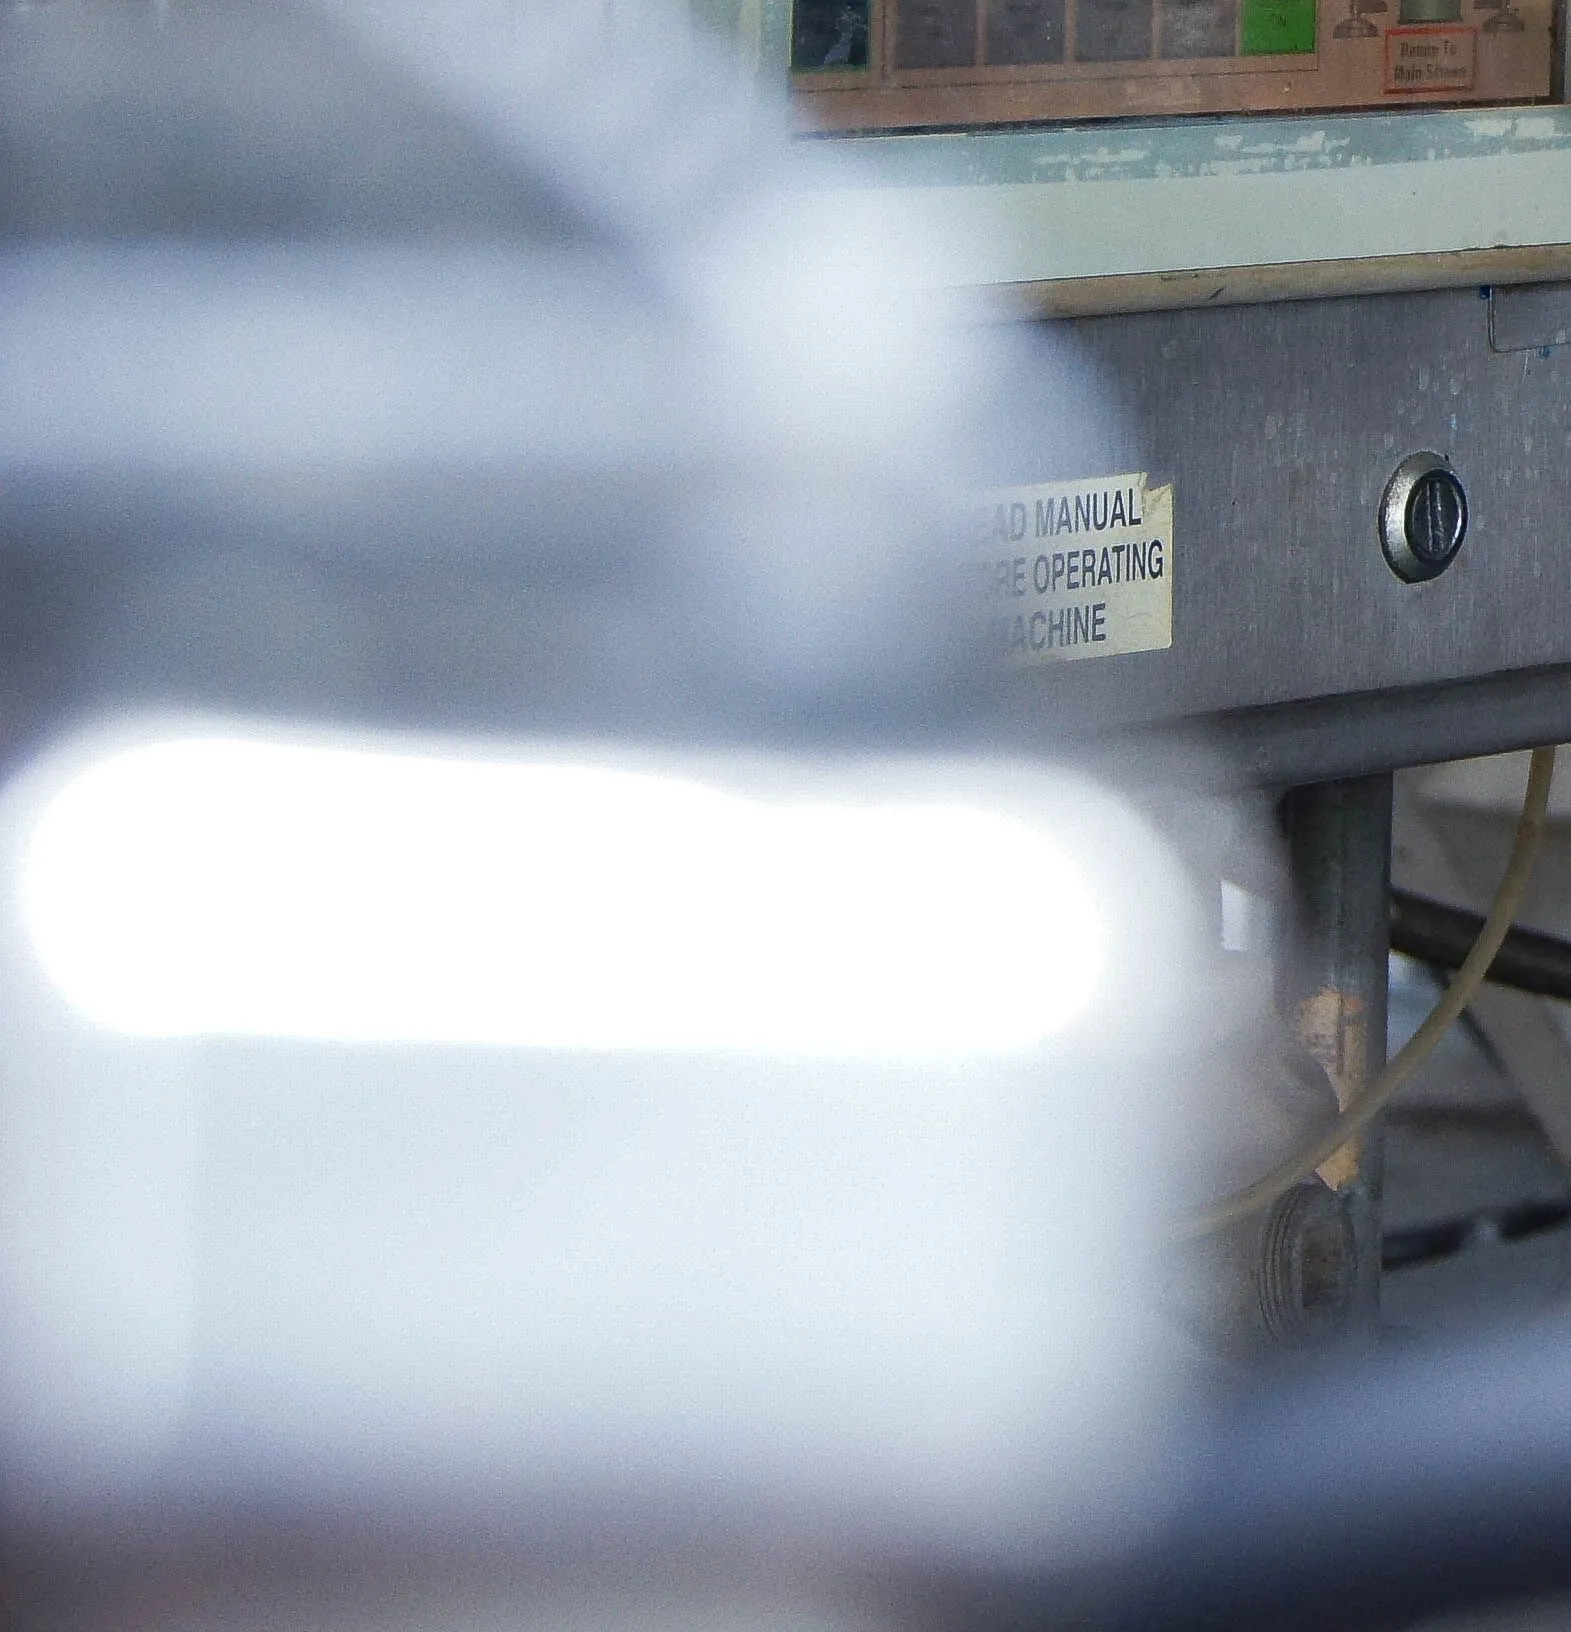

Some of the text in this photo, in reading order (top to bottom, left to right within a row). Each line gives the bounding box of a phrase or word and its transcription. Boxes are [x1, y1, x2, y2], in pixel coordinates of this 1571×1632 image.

[1394, 65, 1423, 82] Main
[1035, 487, 1142, 538] MANUAL
[1033, 539, 1164, 595] OPERATING
[1010, 603, 1107, 651] ACHINE
